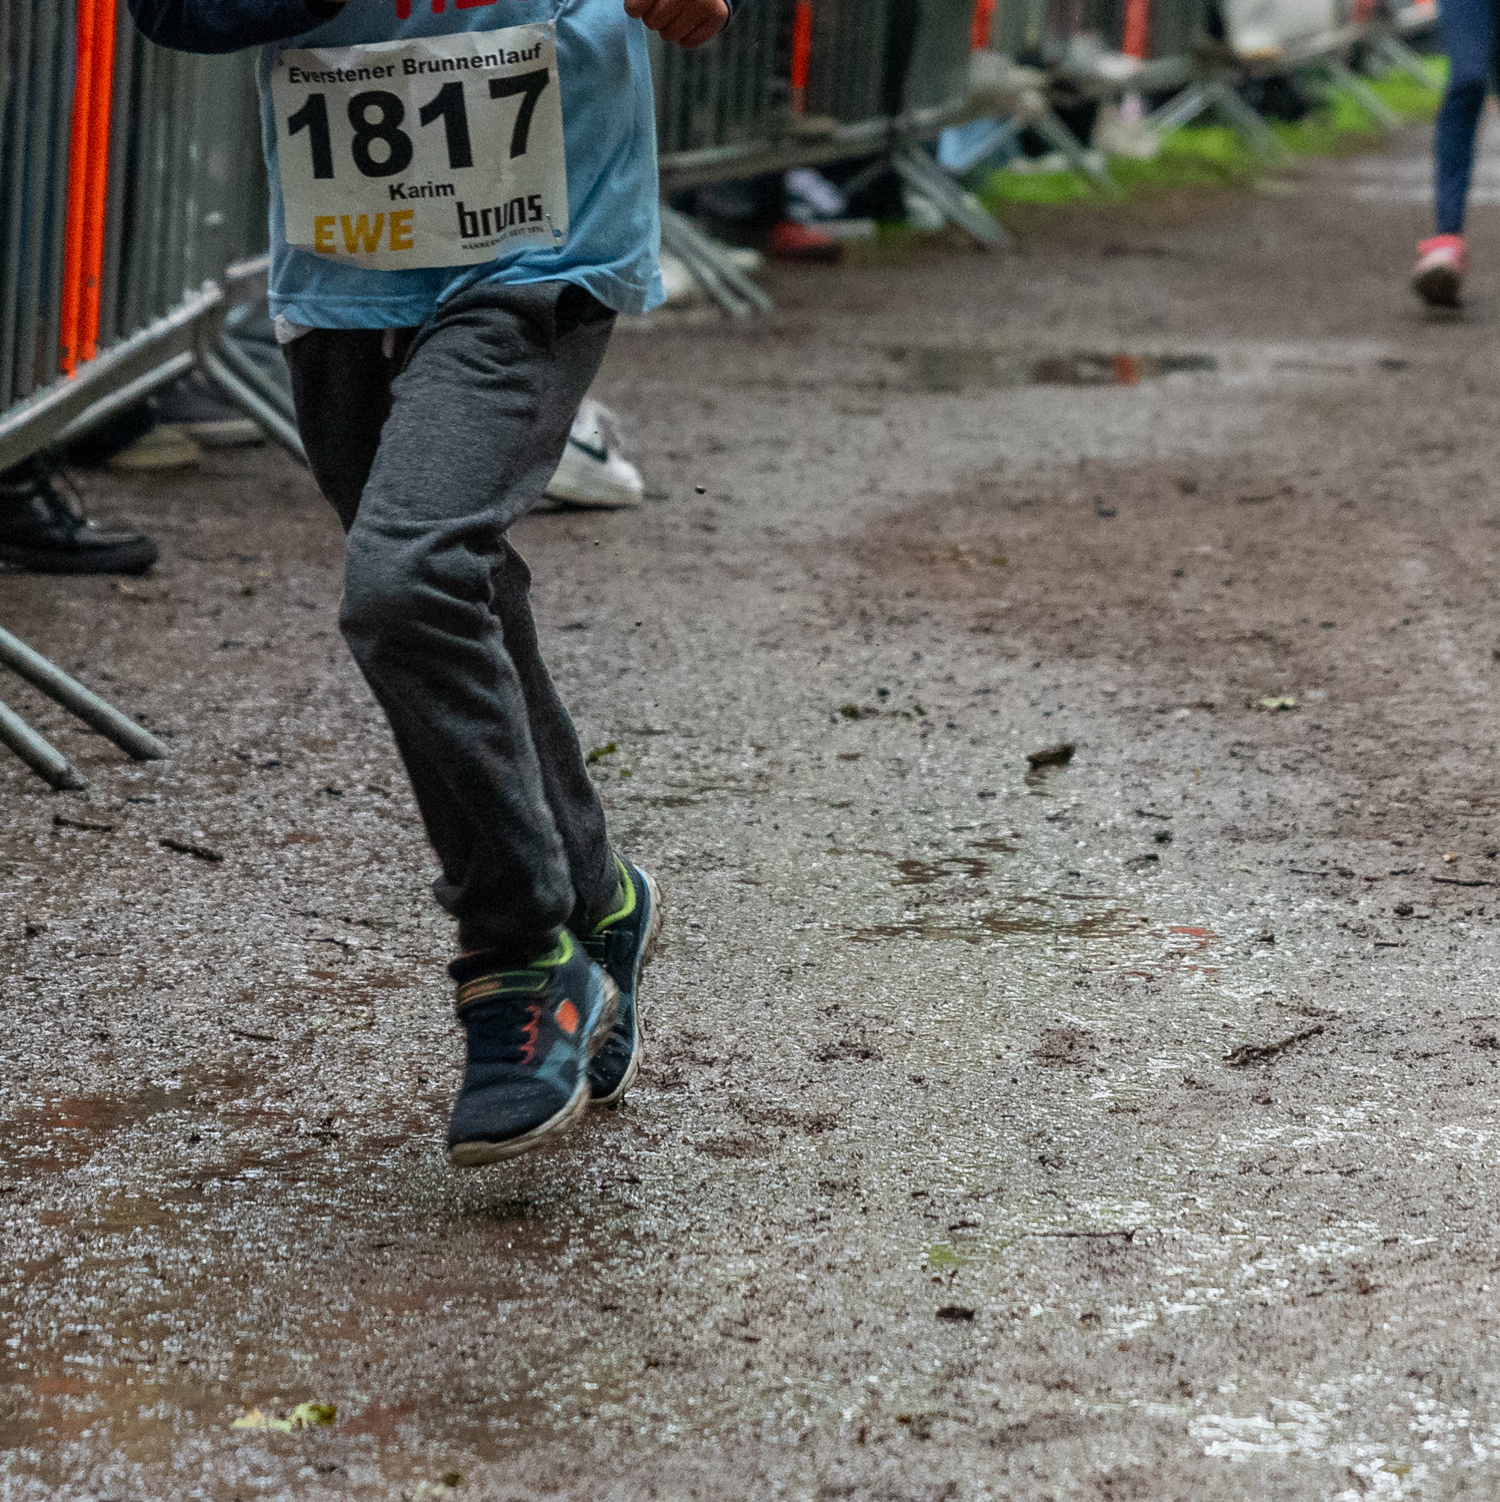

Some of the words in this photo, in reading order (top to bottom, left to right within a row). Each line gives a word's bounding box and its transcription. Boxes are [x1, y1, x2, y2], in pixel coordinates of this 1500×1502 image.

[288, 63, 395, 84] Everstener
[402, 42, 542, 76] Brunnenlauf
[287, 67, 550, 180] 1817
[388, 182, 456, 200] Karim
[313, 209, 415, 254] EWE
[455, 194, 542, 239] bruns
